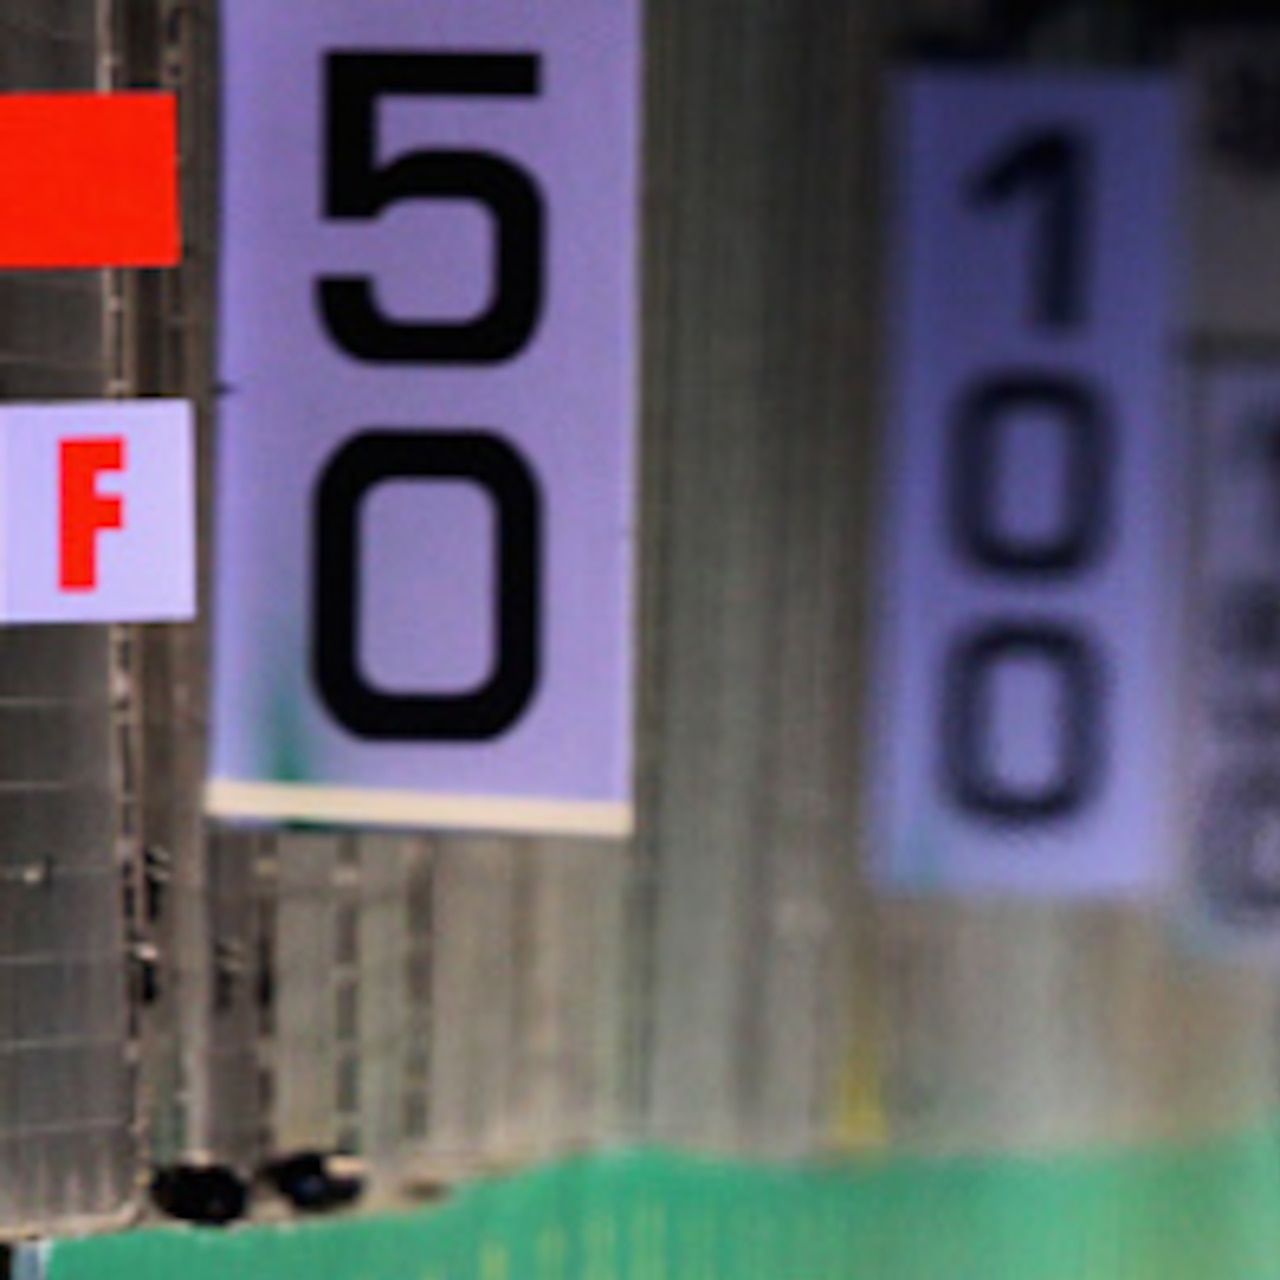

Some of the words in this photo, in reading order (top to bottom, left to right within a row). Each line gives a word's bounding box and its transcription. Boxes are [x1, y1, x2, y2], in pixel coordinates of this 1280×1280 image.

[58, 436, 126, 592] F
[309, 49, 548, 742] 50
[941, 120, 1117, 828] 100
